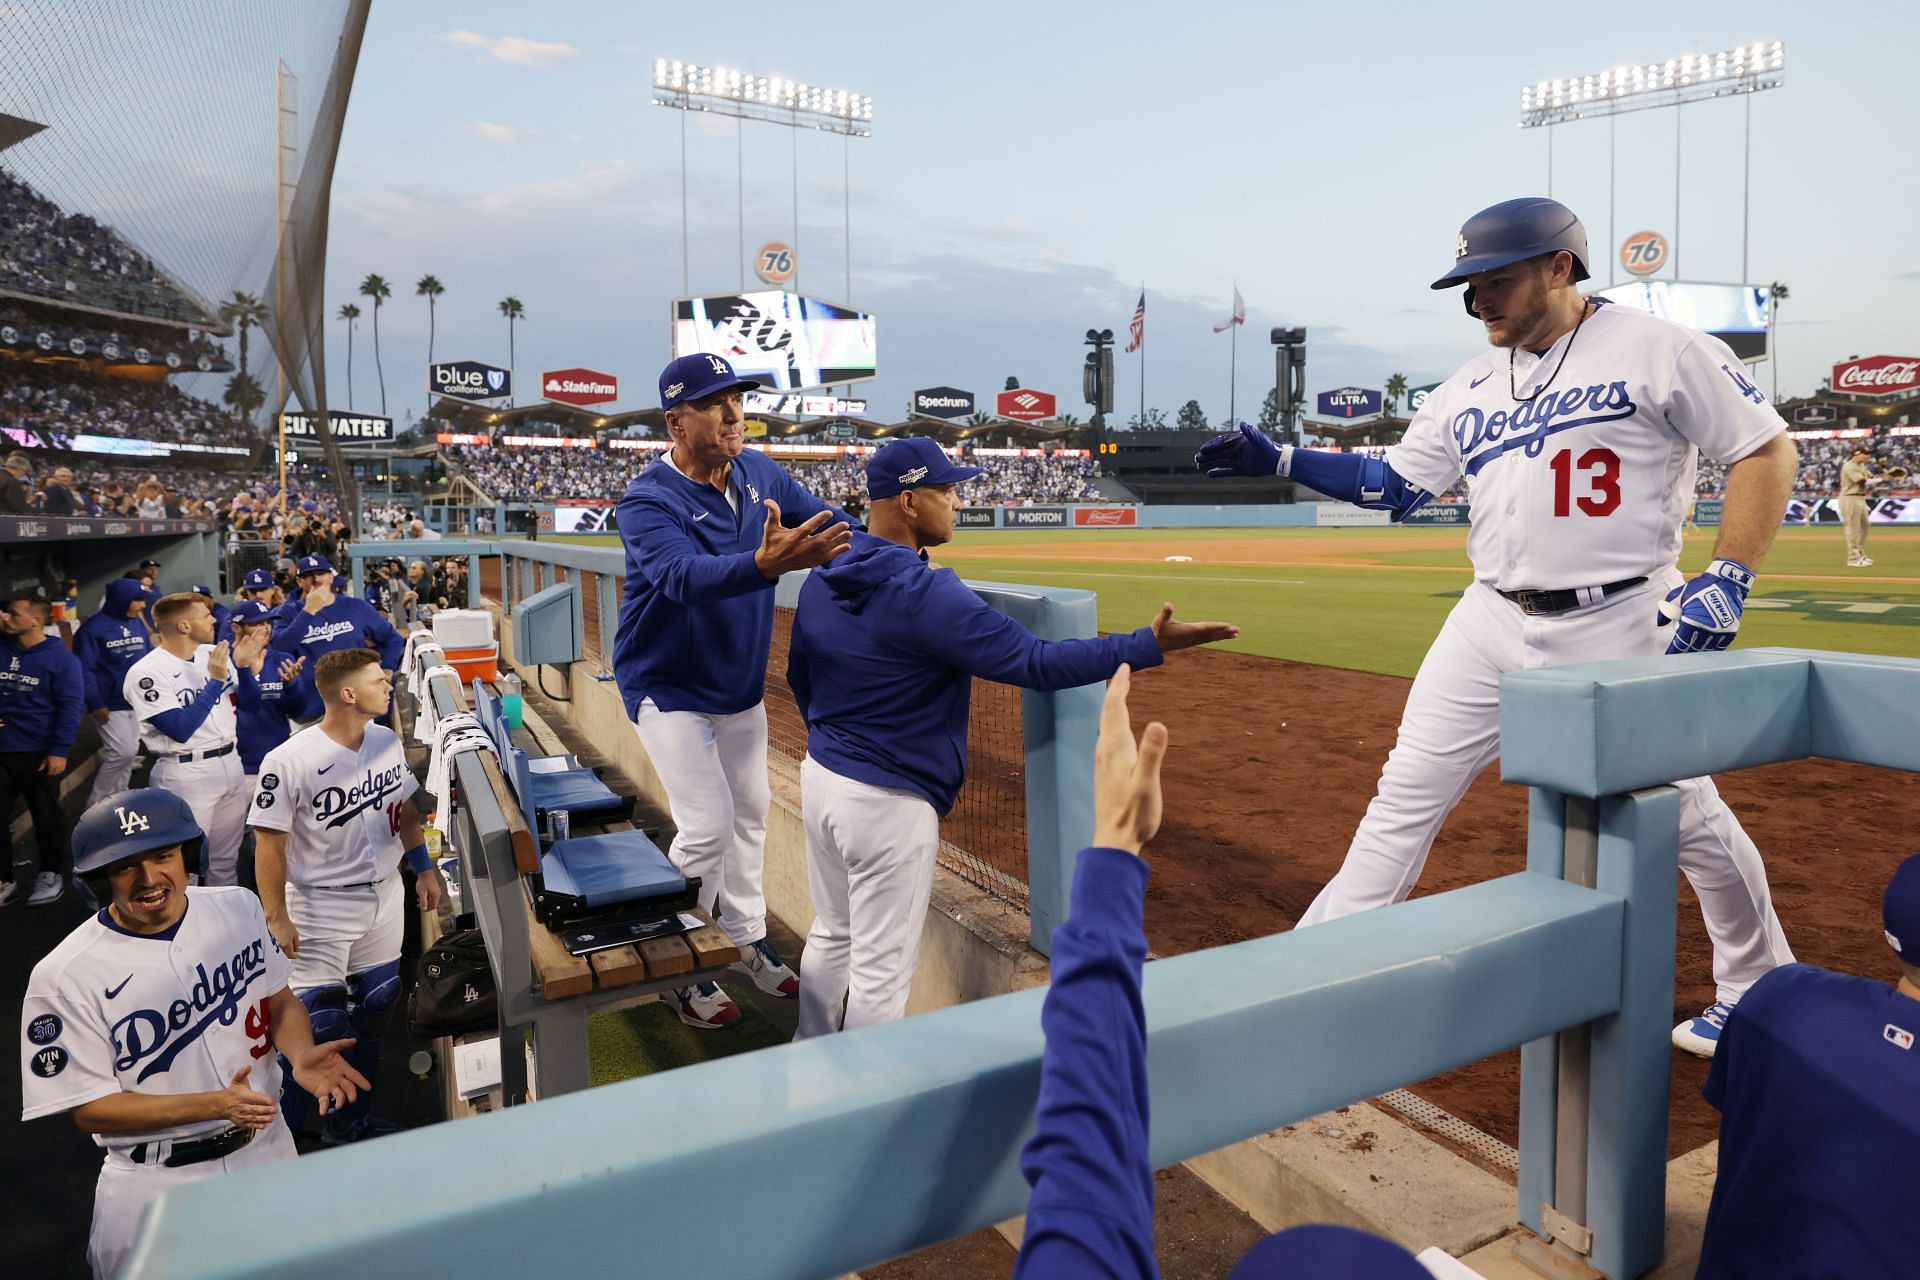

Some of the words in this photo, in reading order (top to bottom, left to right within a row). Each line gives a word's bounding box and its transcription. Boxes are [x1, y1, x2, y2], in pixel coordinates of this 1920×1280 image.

[1629, 239, 1661, 264] 76
[763, 250, 793, 273] 76
[705, 355, 729, 375] LA
[436, 365, 483, 386] blue
[1720, 364, 1766, 405] LA
[444, 385, 489, 396] california
[918, 394, 968, 409] Spectrum
[1330, 395, 1369, 406] ULTRA
[1454, 381, 1637, 472] Dodgers
[1550, 448, 1622, 518] 13
[746, 483, 760, 504] LA
[541, 515, 552, 525] 76
[962, 513, 990, 523] Health
[1018, 512, 1062, 523] MORTON
[1706, 591, 1734, 625] Franklin
[260, 793, 273, 801] VIN
[114, 806, 150, 836] LA
[463, 983, 479, 1002] LA
[33, 1022, 56, 1040] 30
[34, 1017, 54, 1027] MAURY
[38, 1049, 60, 1064] VIN
